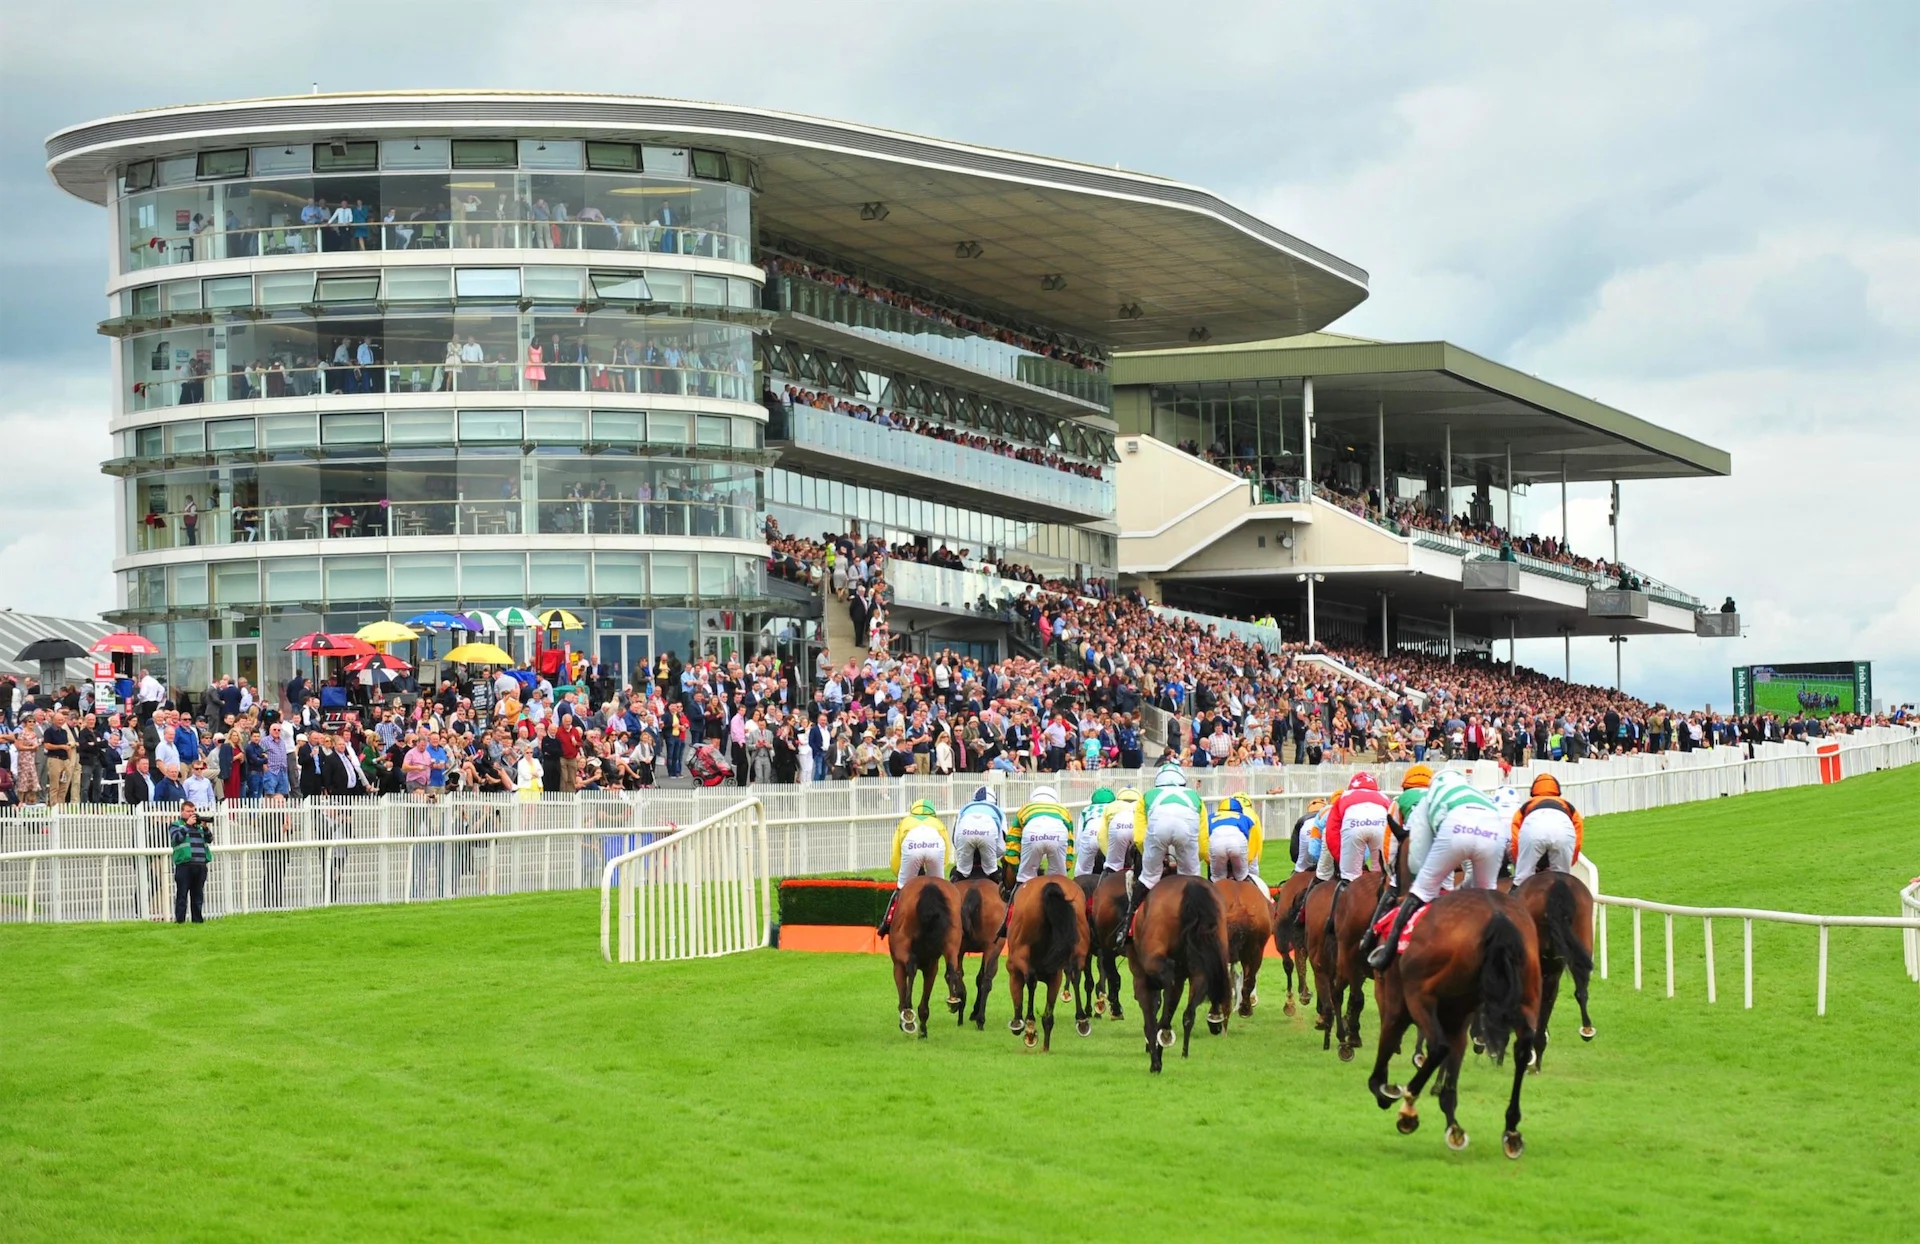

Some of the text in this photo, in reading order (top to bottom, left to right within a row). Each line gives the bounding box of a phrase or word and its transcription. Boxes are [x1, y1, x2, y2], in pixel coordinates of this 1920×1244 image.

[1738, 688, 1746, 717] Indepen
[1858, 683, 1868, 716] Independ
[1116, 822, 1134, 830] Stob
[1350, 818, 1385, 828] Stobart
[962, 828, 990, 836] Stobart
[1452, 824, 1499, 841] Stobart
[1030, 833, 1060, 842] Stobart
[907, 841, 939, 850] Stobart
